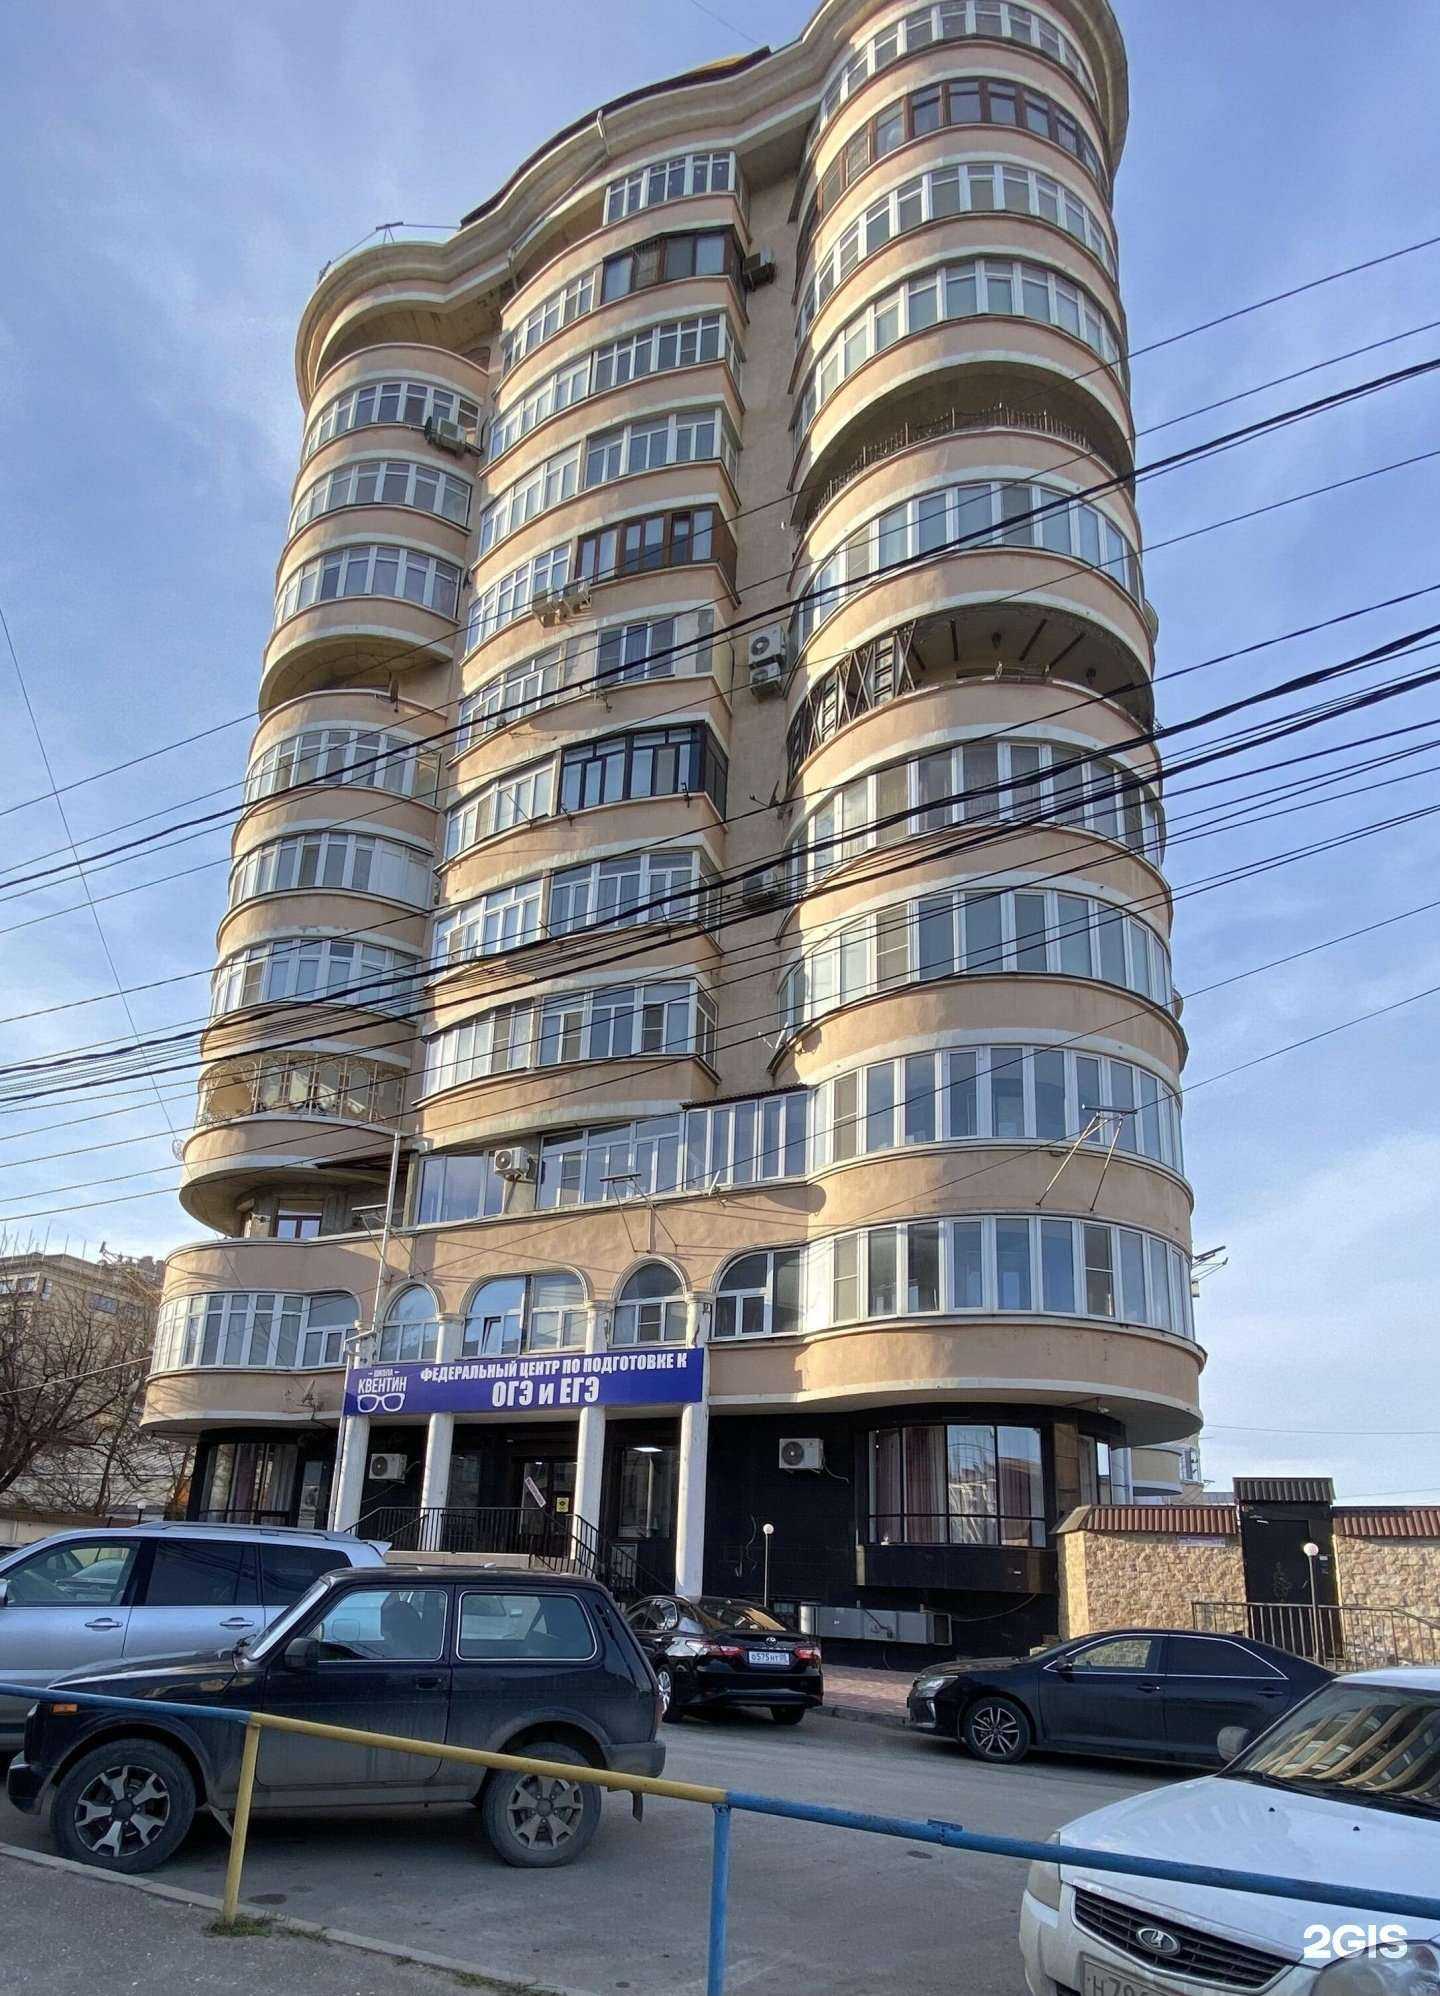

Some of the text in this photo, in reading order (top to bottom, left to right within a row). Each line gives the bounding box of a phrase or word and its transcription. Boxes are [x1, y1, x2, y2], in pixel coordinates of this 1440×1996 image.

[420, 1352, 687, 1383] ФЕДЕРАЛЬНЫЙ ЦЕНТР ПО ПОДГОТОВКЕ К
[358, 1376, 407, 1393] КВЕНТИН
[492, 1380, 534, 1407] ОГЭ
[560, 1376, 599, 1404] ЕГЭ
